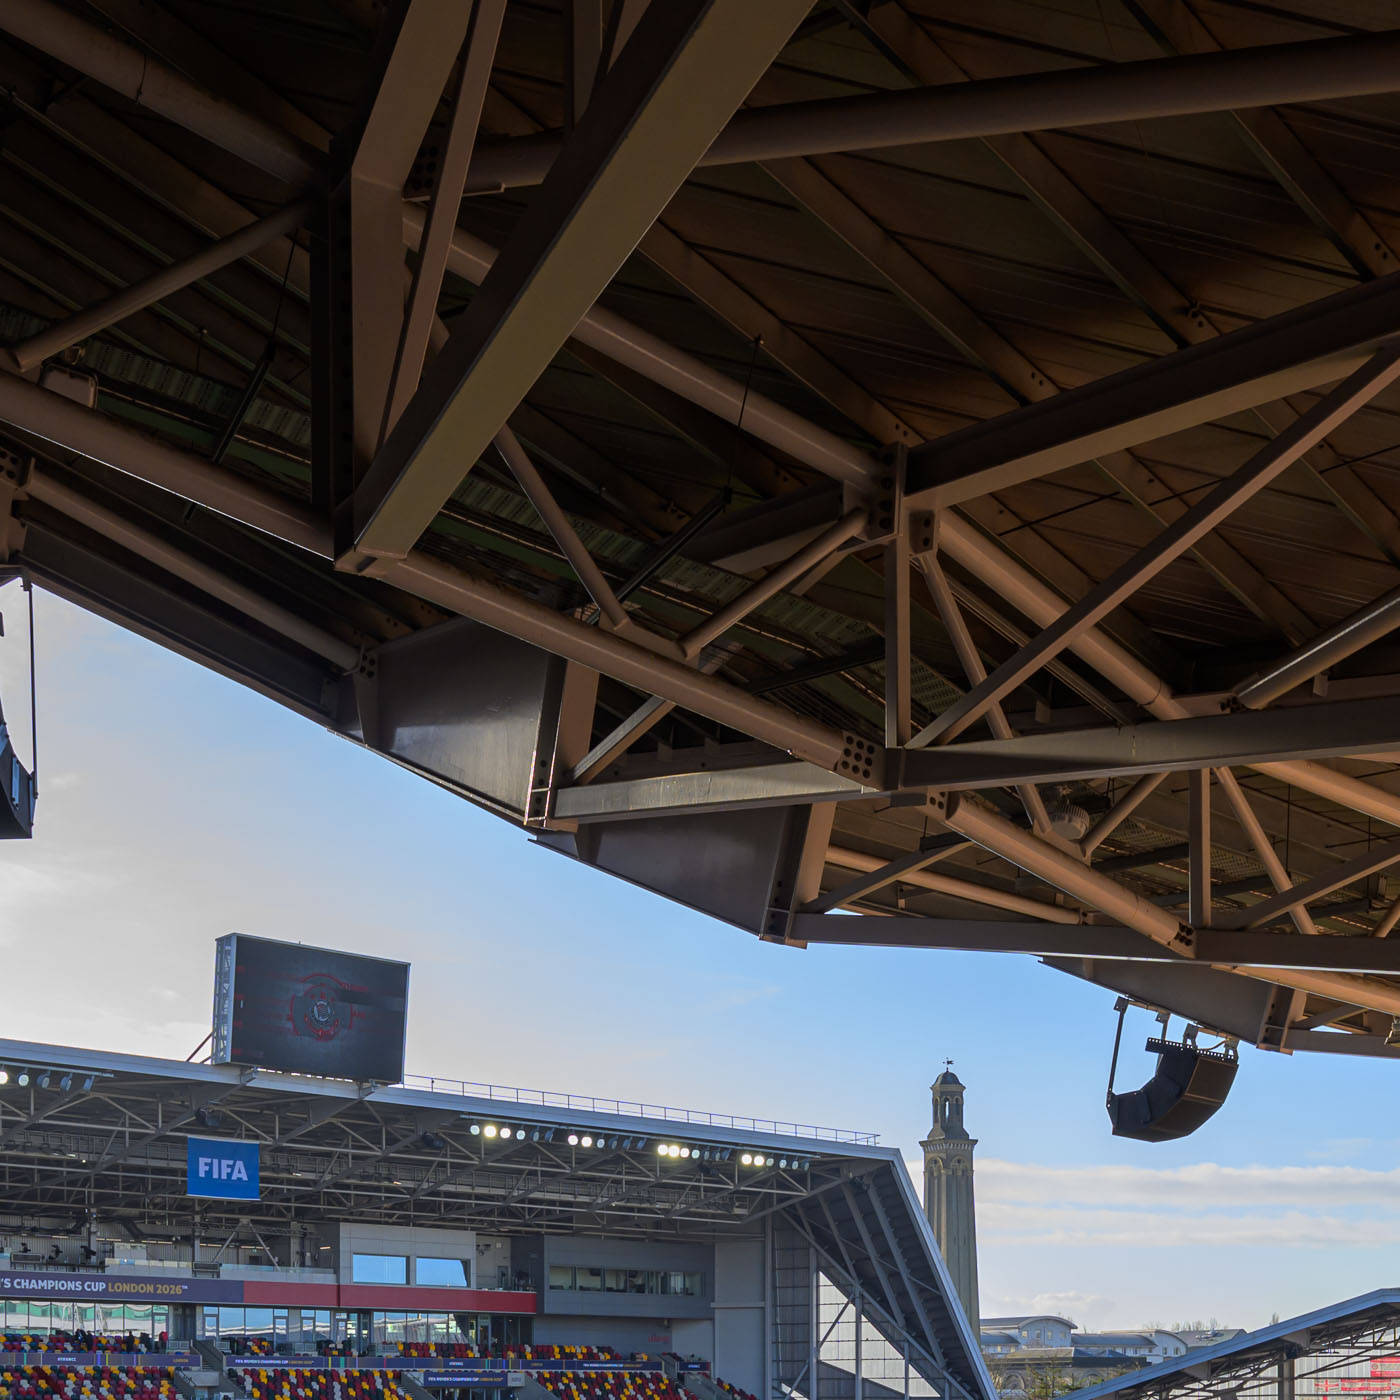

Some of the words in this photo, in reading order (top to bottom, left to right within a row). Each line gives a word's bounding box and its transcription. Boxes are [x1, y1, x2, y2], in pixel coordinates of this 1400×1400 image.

[198, 1157, 249, 1182] FIFA
[13, 1277, 82, 1291] CHAMPIONS
[84, 1280, 106, 1292] CUP
[108, 1282, 154, 1294] LONDON
